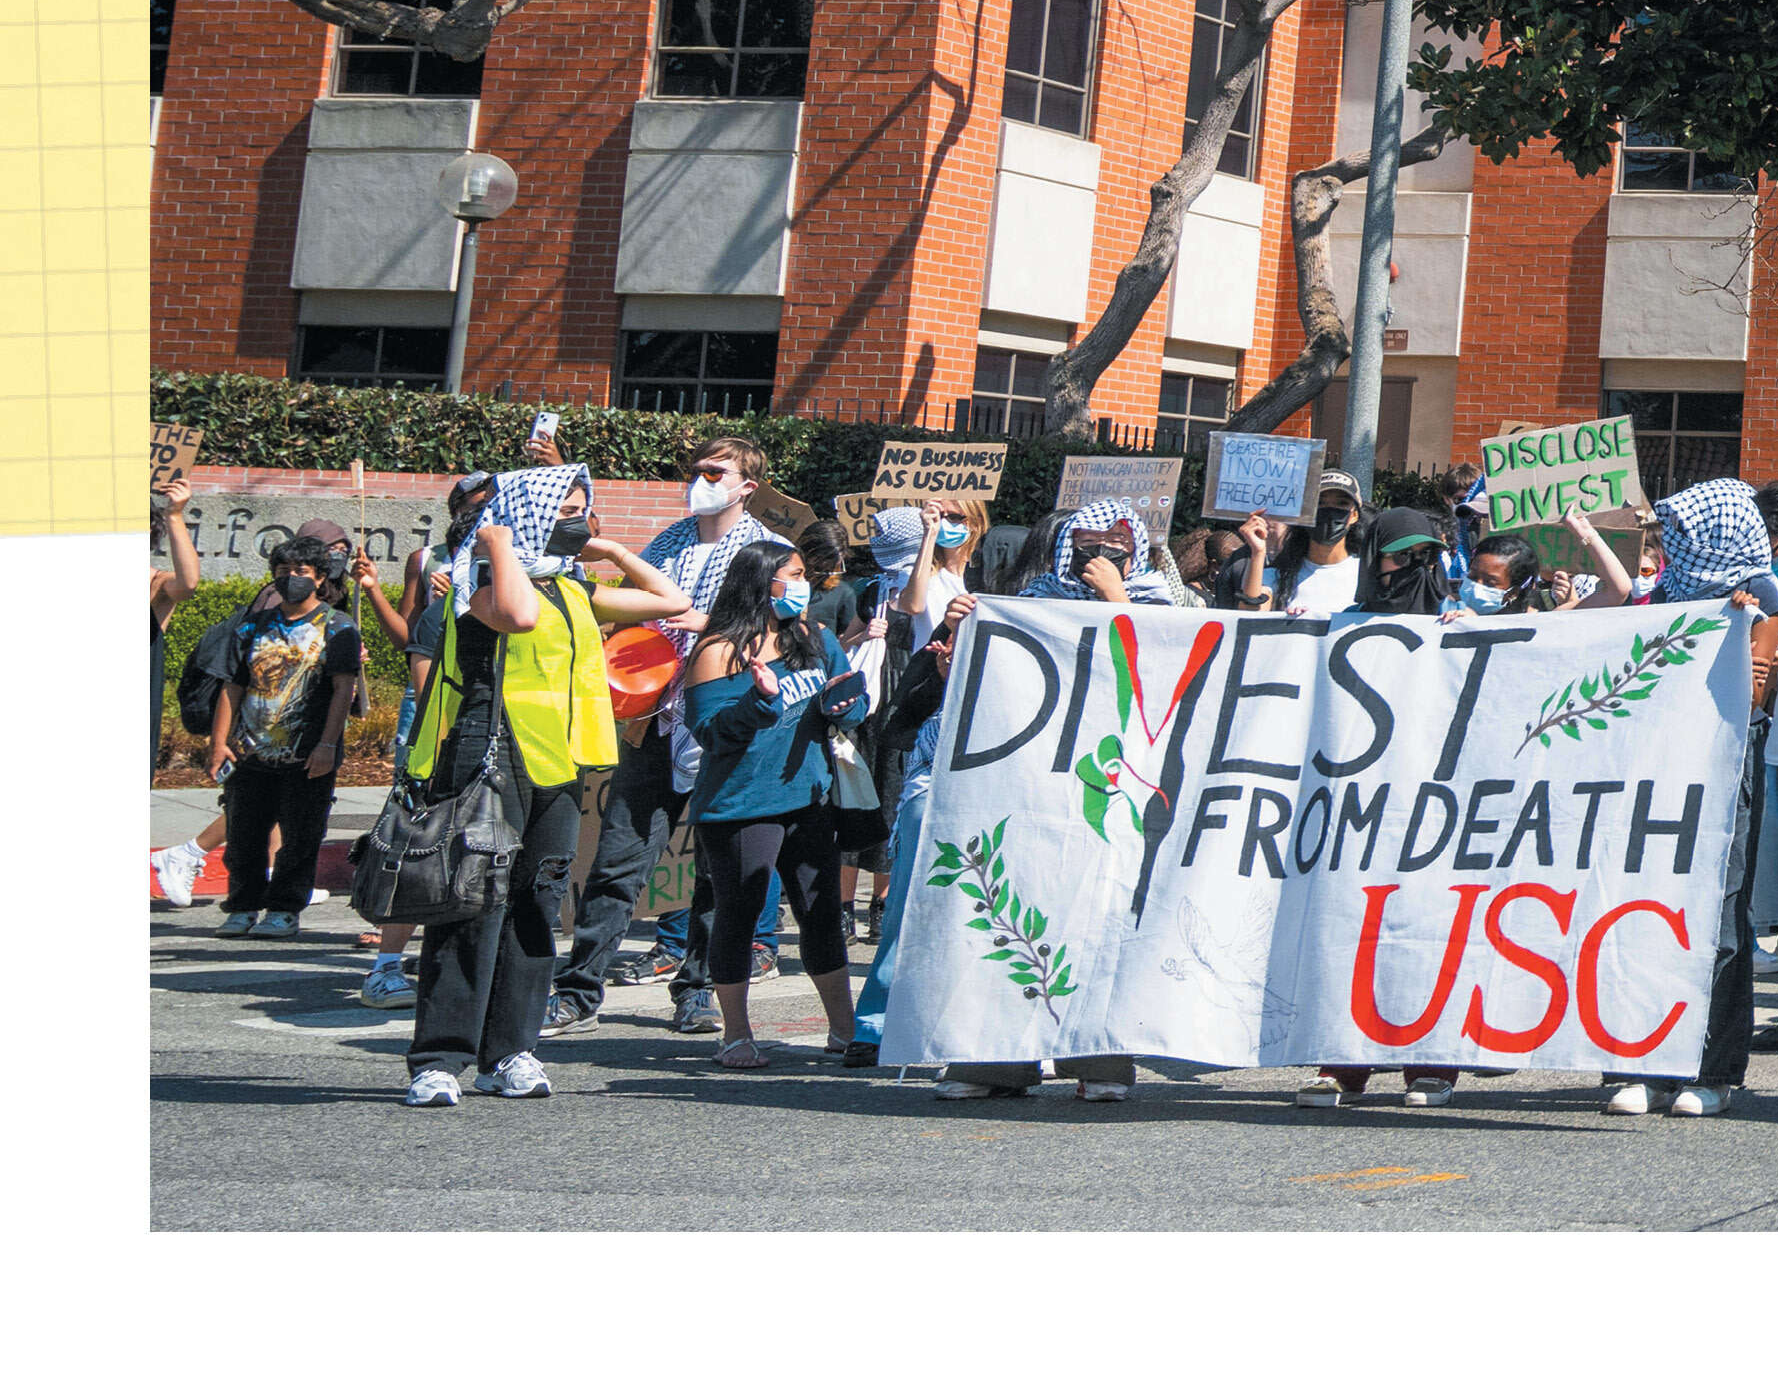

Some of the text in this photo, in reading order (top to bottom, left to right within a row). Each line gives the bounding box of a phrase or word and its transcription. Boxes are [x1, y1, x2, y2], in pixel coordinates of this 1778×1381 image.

[154, 424, 200, 448] THE
[1483, 418, 1633, 479] DISCLOSE
[883, 447, 1005, 473] NO BUSINESS
[1069, 463, 1112, 477] NOTHING
[1135, 461, 1175, 476] JUSTIFY
[1237, 456, 1289, 478] NOW
[150, 464, 184, 495] EA
[875, 469, 993, 492] AS USUAL
[1219, 481, 1297, 508] FREE GAZA
[1488, 469, 1628, 531] DIVEST
[950, 613, 1536, 929] DIVEST
[1181, 779, 1704, 879] FROM DEATH
[1350, 882, 1692, 1058] USC
